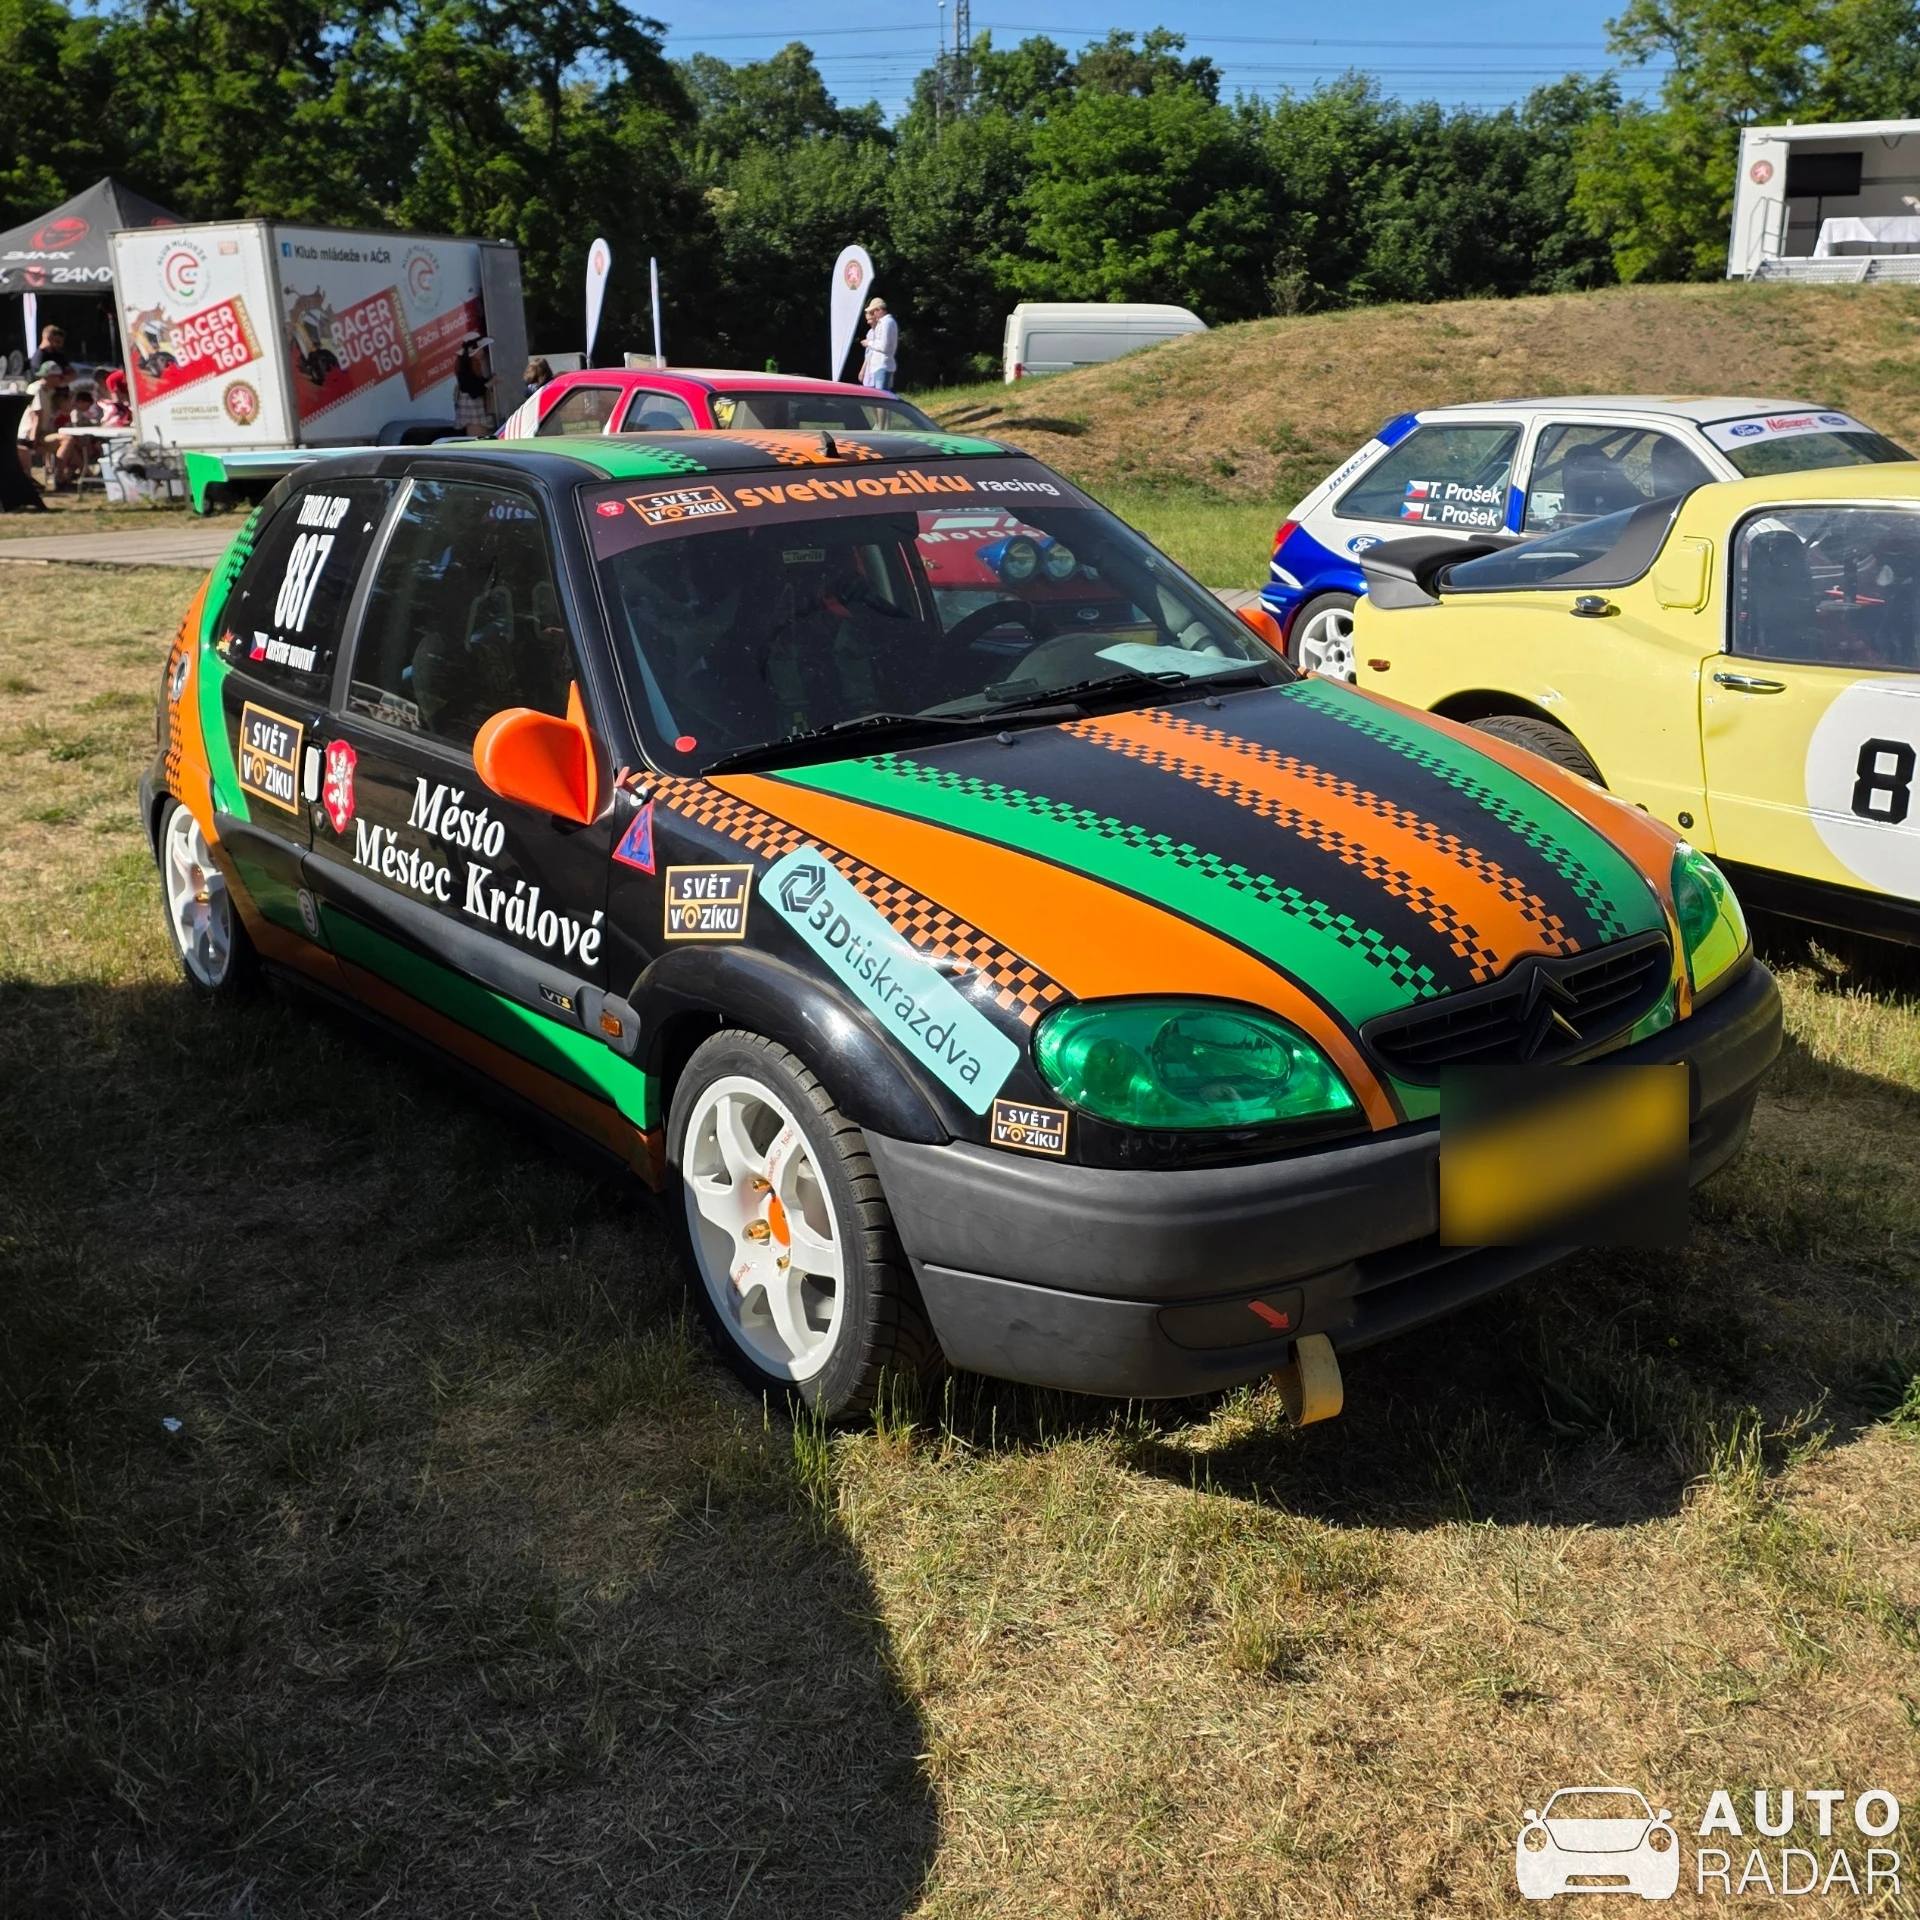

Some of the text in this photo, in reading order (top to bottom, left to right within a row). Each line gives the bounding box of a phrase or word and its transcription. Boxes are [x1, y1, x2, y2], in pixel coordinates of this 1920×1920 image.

[294, 245, 318, 260] Klub
[320, 247, 360, 263] mládeže
[370, 249, 392, 263] AČR
[170, 306, 236, 347] RACER
[330, 299, 392, 345] RACER
[175, 323, 240, 367] BUGGY
[212, 342, 249, 371] 160
[337, 321, 396, 371] BUGGY
[371, 344, 403, 376] 160
[1734, 425, 1761, 436] Ford
[651, 492, 702, 507] SVĚT
[740, 471, 1060, 507] svetvoziku racing
[1429, 482, 1503, 505] T. Prošek
[324, 496, 350, 529] CUP
[647, 501, 727, 521] VOZÍKU
[1423, 503, 1498, 527] L. Prošek
[274, 532, 336, 632] 887
[252, 721, 288, 758] SVĚT
[243, 754, 293, 800] VOZÍKU
[1851, 738, 1917, 825] 8
[407, 776, 505, 857] Město
[352, 817, 604, 966] Městec Králové
[682, 873, 731, 898] SVĚT
[671, 904, 739, 930] VOZÍKU
[543, 989, 571, 1009] VTS
[808, 899, 982, 1086] 3Dtiskrazdva
[1008, 1109, 1051, 1128] SVĚT
[997, 1125, 1059, 1149] VOZÍKU
